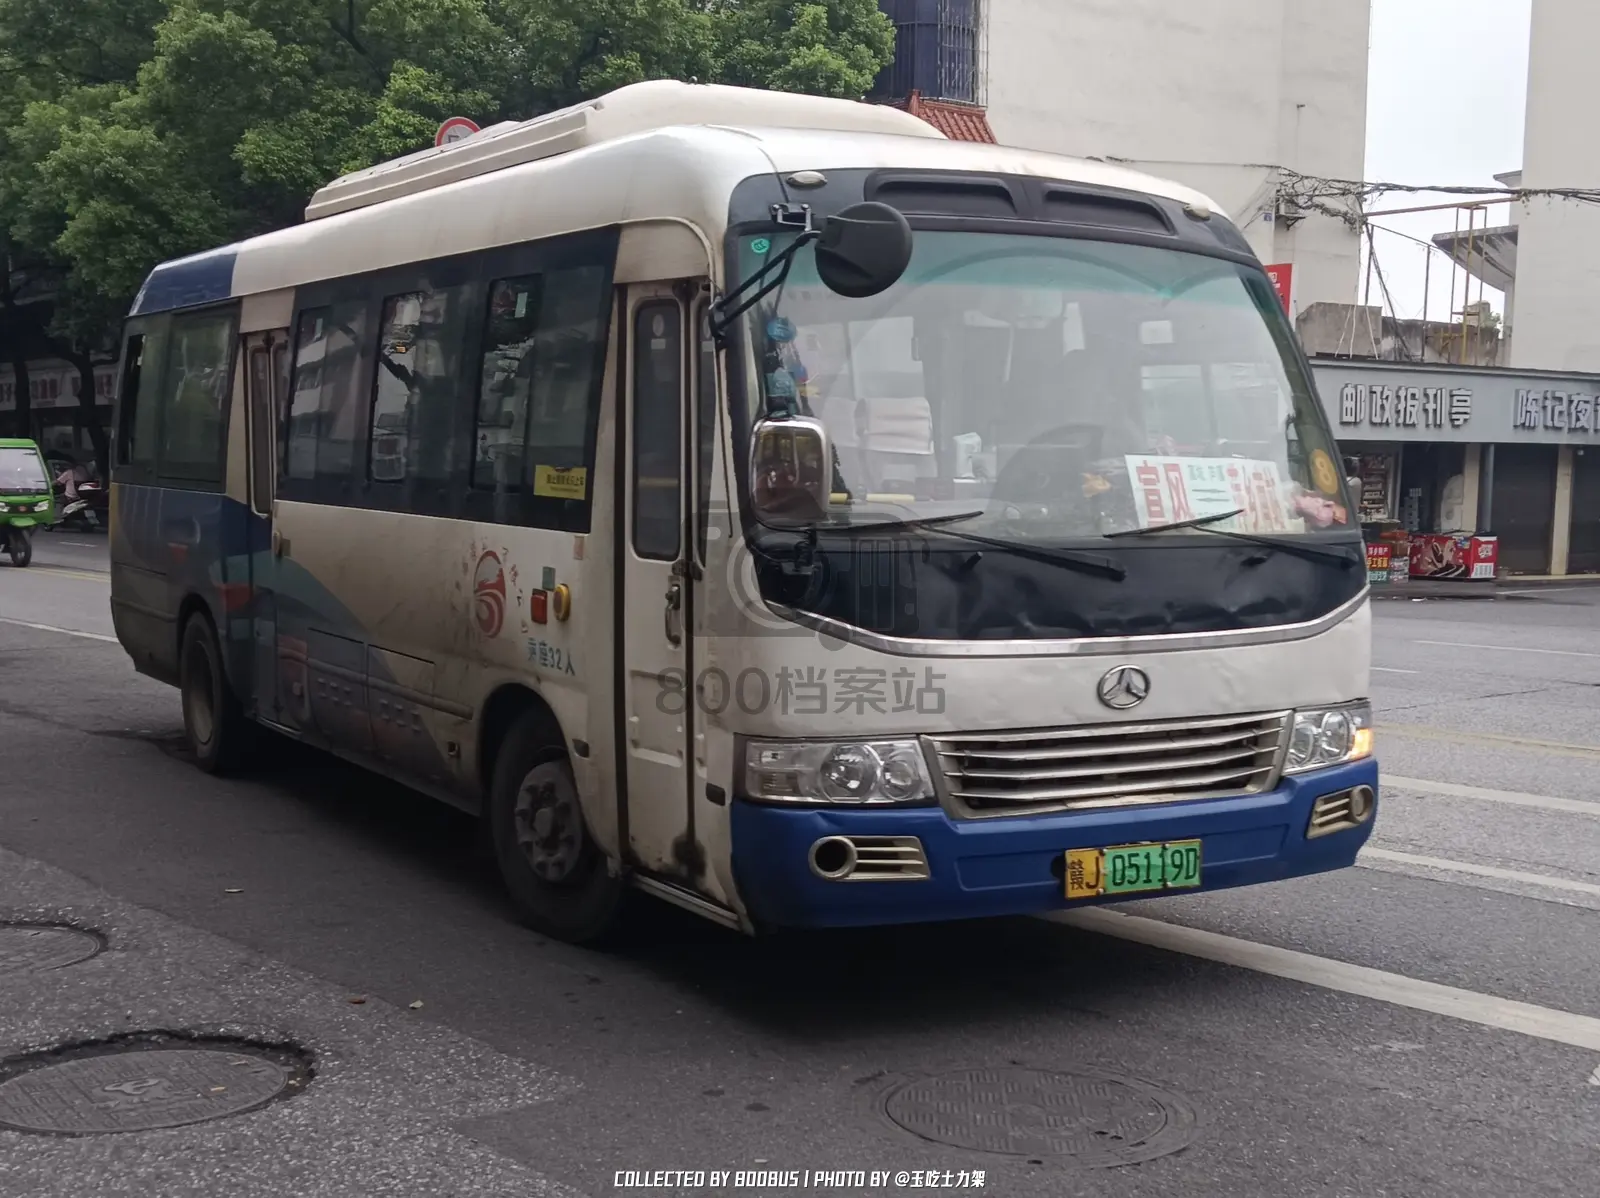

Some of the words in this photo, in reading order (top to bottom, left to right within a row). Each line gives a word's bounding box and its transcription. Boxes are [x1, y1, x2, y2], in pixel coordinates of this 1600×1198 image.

[1341, 383, 1473, 426] 邮政报刊亭
[1516, 389, 1600, 429] 陈记夜
